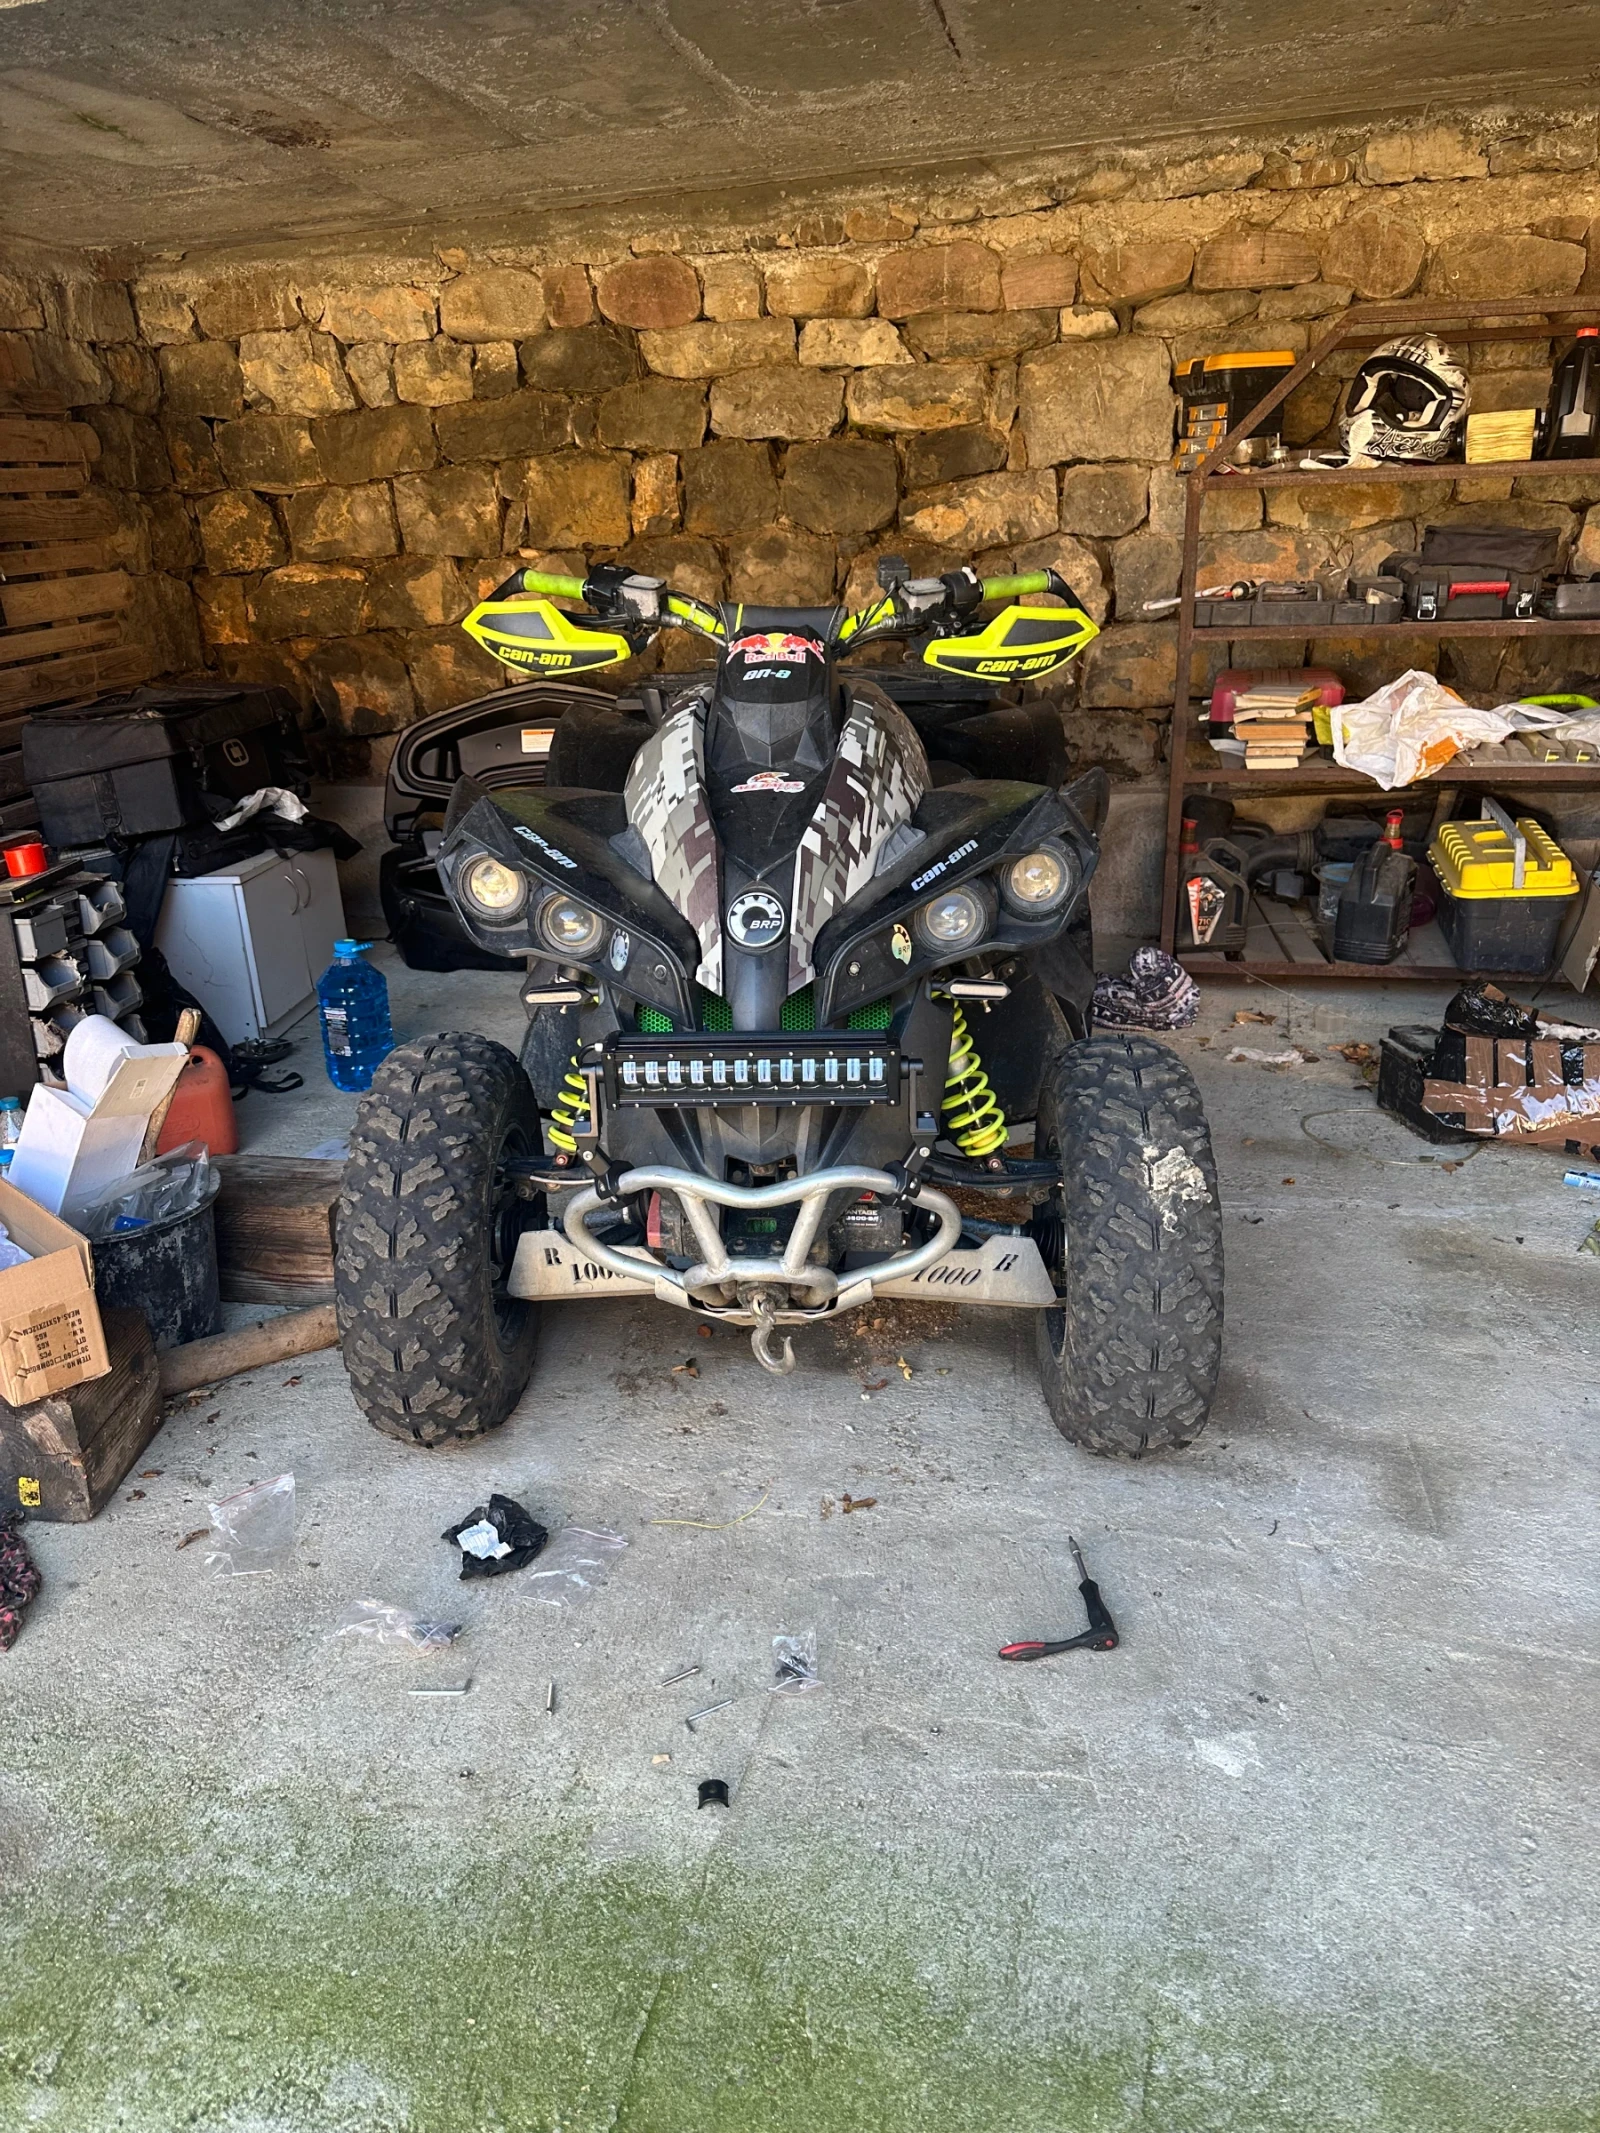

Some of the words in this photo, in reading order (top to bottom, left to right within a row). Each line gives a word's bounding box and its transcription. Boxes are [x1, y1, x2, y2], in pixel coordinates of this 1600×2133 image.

[499, 646, 572, 666] can-am
[744, 652, 775, 664] Red
[776, 651, 806, 664] Bull
[976, 654, 1057, 672] can-am
[513, 826, 578, 868] can-am
[911, 839, 979, 891] can-am
[750, 920, 780, 929] BRP
[543, 1247, 562, 1265] R
[34, 1331, 48, 1341] KGS
[37, 1340, 50, 1351] KGS
[39, 1349, 52, 1360] PCS
[76, 1354, 91, 1365] ITEM
